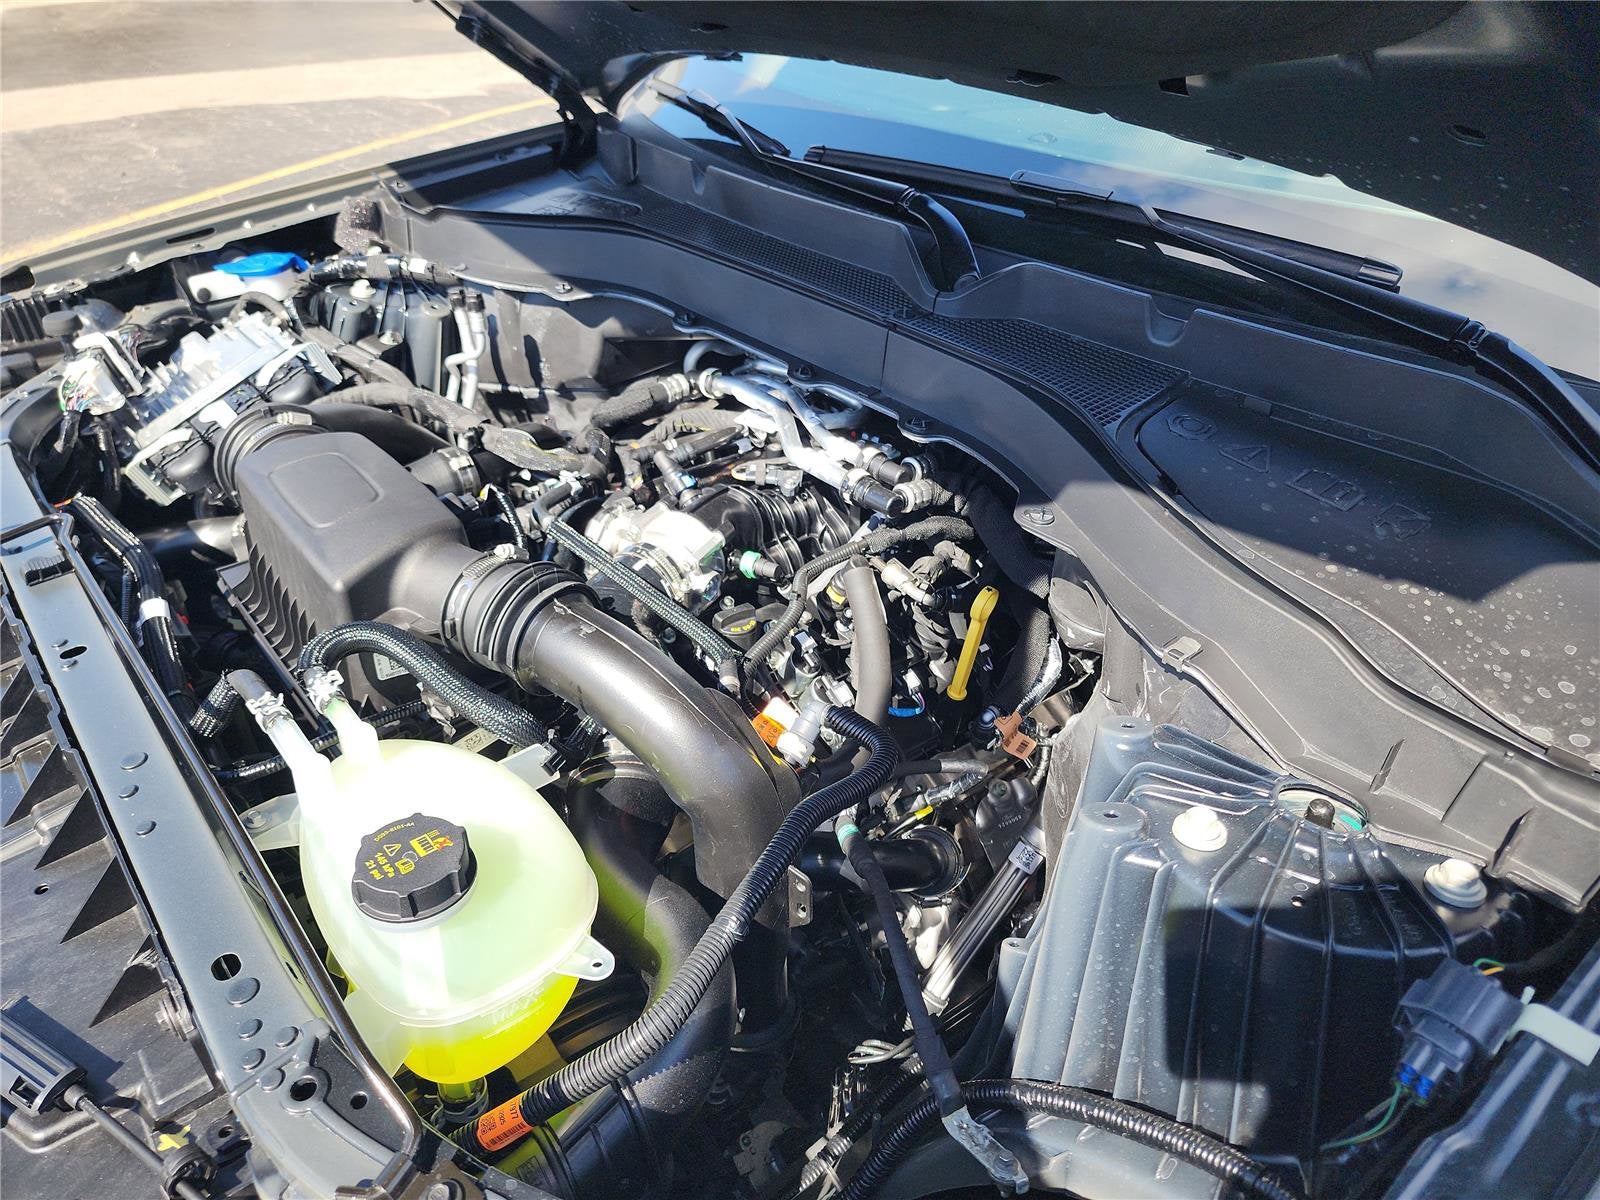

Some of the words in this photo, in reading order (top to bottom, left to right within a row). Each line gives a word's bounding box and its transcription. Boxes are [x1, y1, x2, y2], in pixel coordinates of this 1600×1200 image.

[365, 860, 376, 869] 21
[375, 852, 387, 865] 145
[383, 864, 395, 878] kPa
[370, 869, 384, 880] psi
